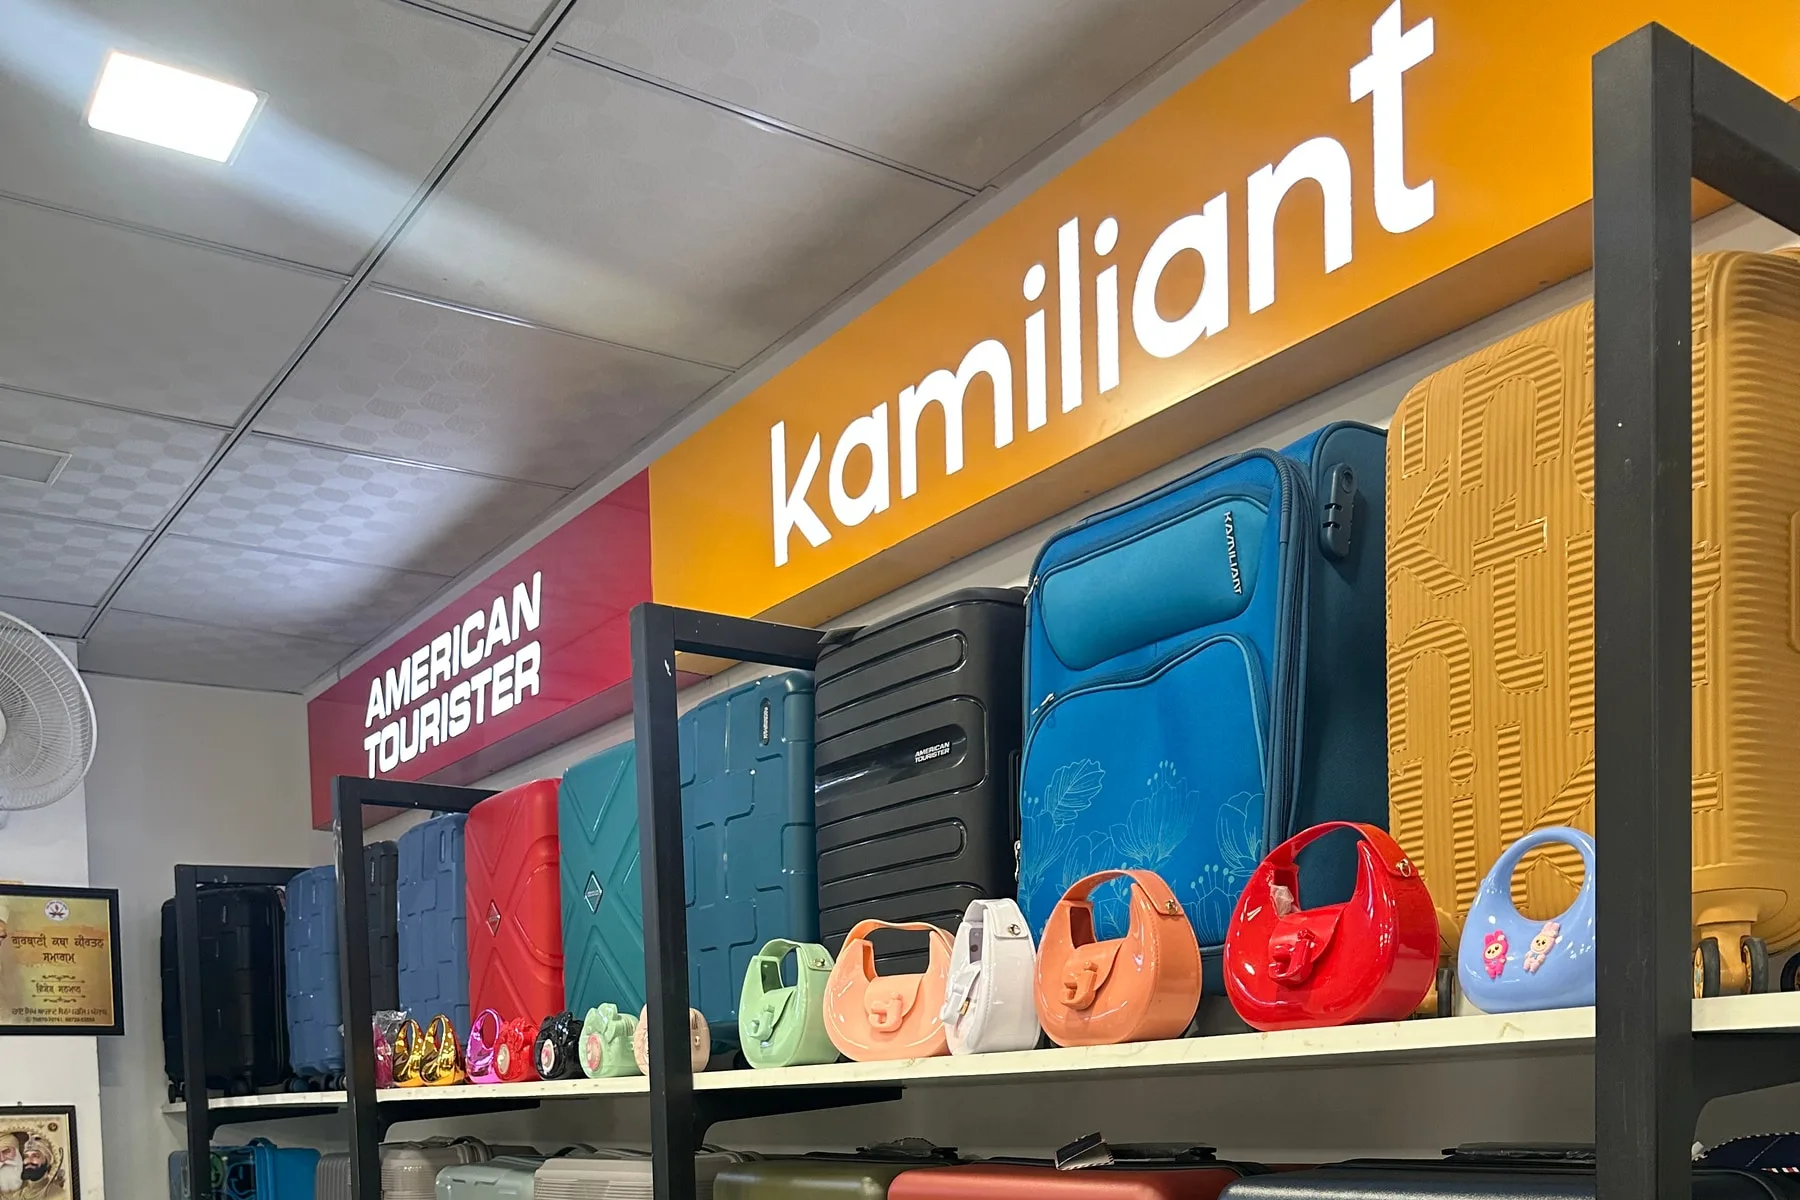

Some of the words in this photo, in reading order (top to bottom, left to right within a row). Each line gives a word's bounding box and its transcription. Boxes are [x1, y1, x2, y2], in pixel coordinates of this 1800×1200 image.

[771, 0, 1435, 568] kamiliant
[1224, 511, 1242, 594] KAMILIANT
[365, 571, 542, 728] AMERICAN
[364, 641, 541, 779] TOURISTER
[914, 741, 950, 758] AMERICAN
[914, 747, 950, 763] TOURISTER
